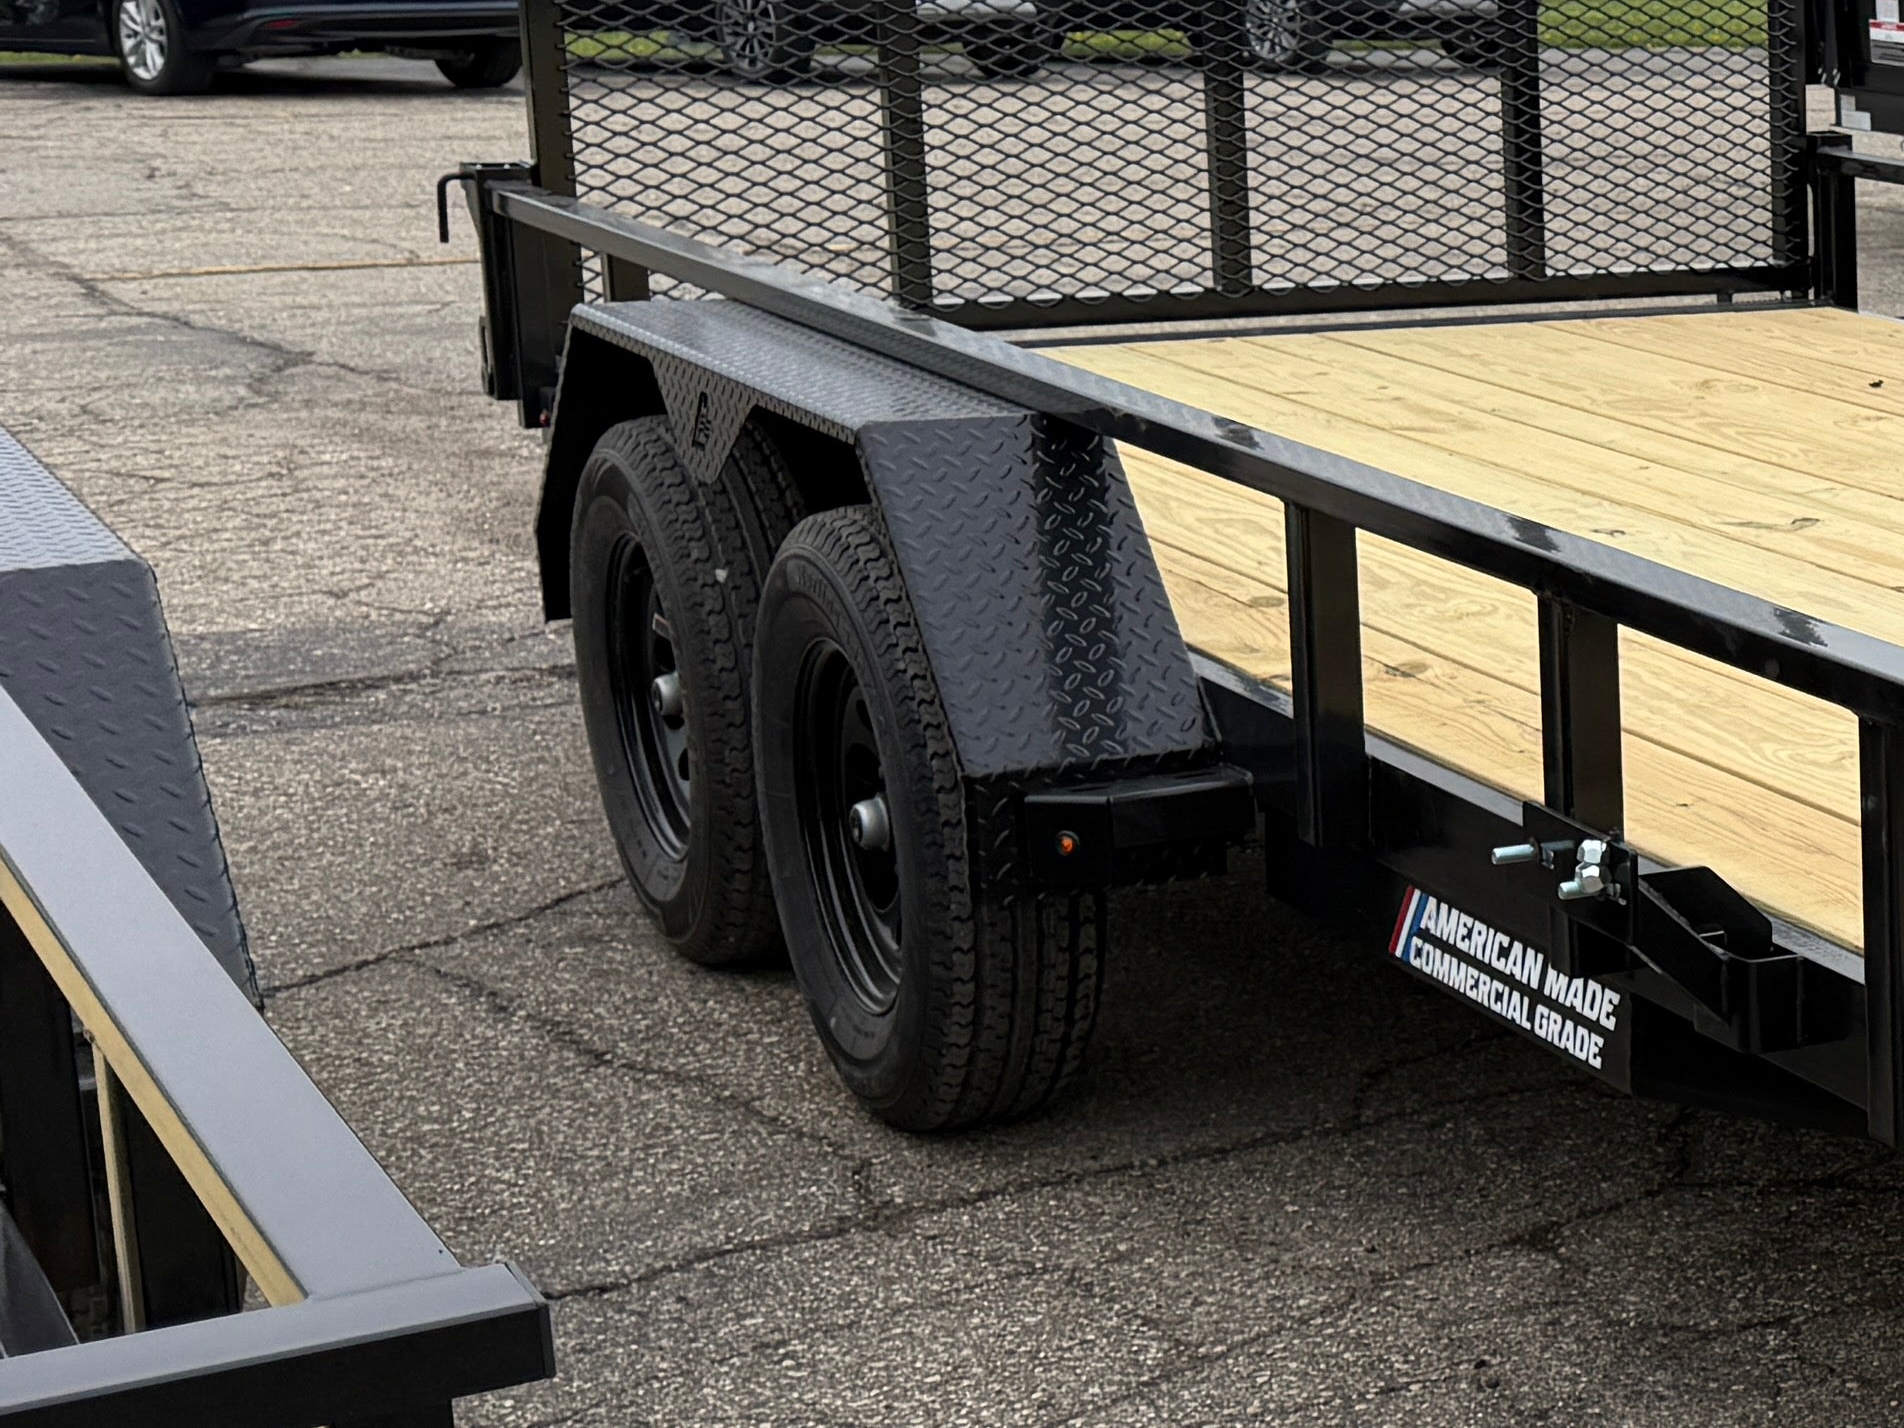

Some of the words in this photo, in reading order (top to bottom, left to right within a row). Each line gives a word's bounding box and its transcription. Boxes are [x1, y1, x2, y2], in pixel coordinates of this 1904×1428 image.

[1408, 935, 1532, 1032] COMMERCIAL
[1533, 1006, 1605, 1071] GRADE
[1419, 896, 1545, 991] AMERICAN
[1543, 963, 1621, 1032] MADE
